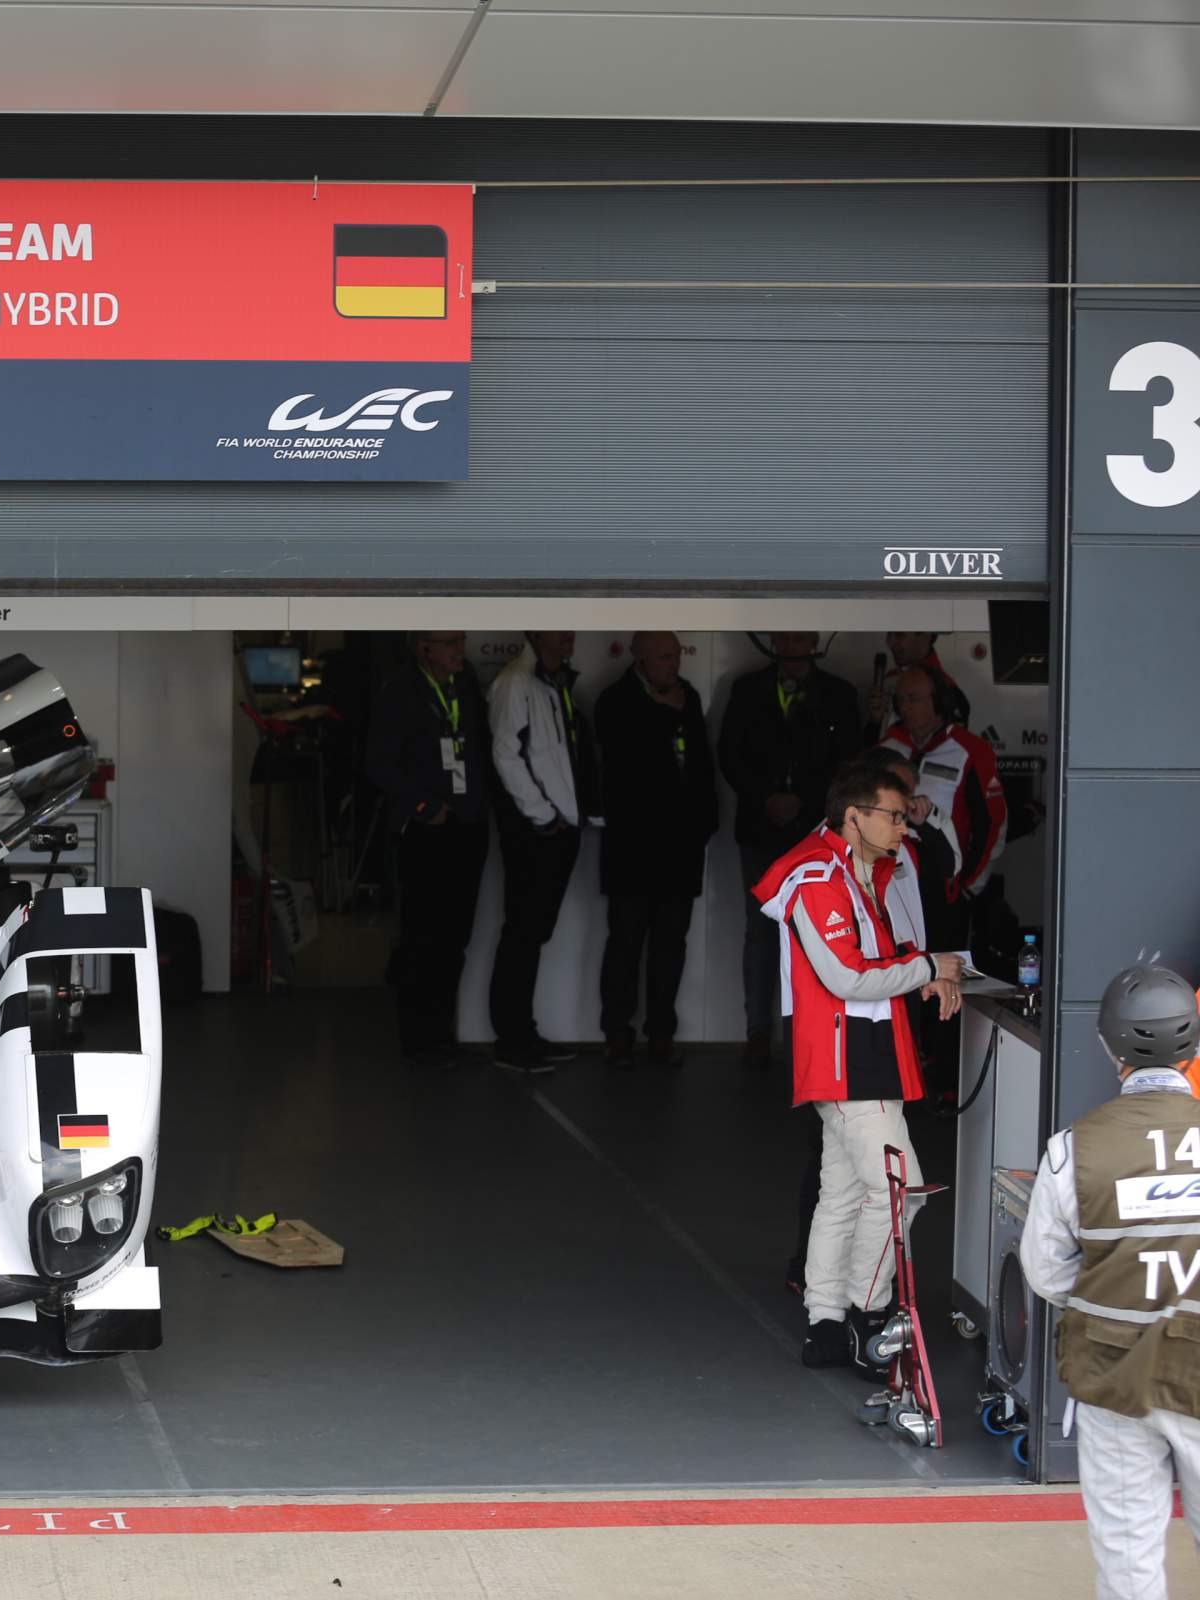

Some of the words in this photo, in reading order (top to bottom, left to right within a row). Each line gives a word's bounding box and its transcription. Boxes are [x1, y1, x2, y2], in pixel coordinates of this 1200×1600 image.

[267, 387, 455, 432] WEC
[1106, 341, 1200, 507] 3
[216, 438, 239, 448] FIA
[243, 438, 292, 448] WORLD
[293, 438, 386, 448] ENDURANCE
[273, 450, 380, 460] CHAMPIONSHIP
[883, 551, 1003, 576] OLIVER
[1138, 1248, 1200, 1301] TV
